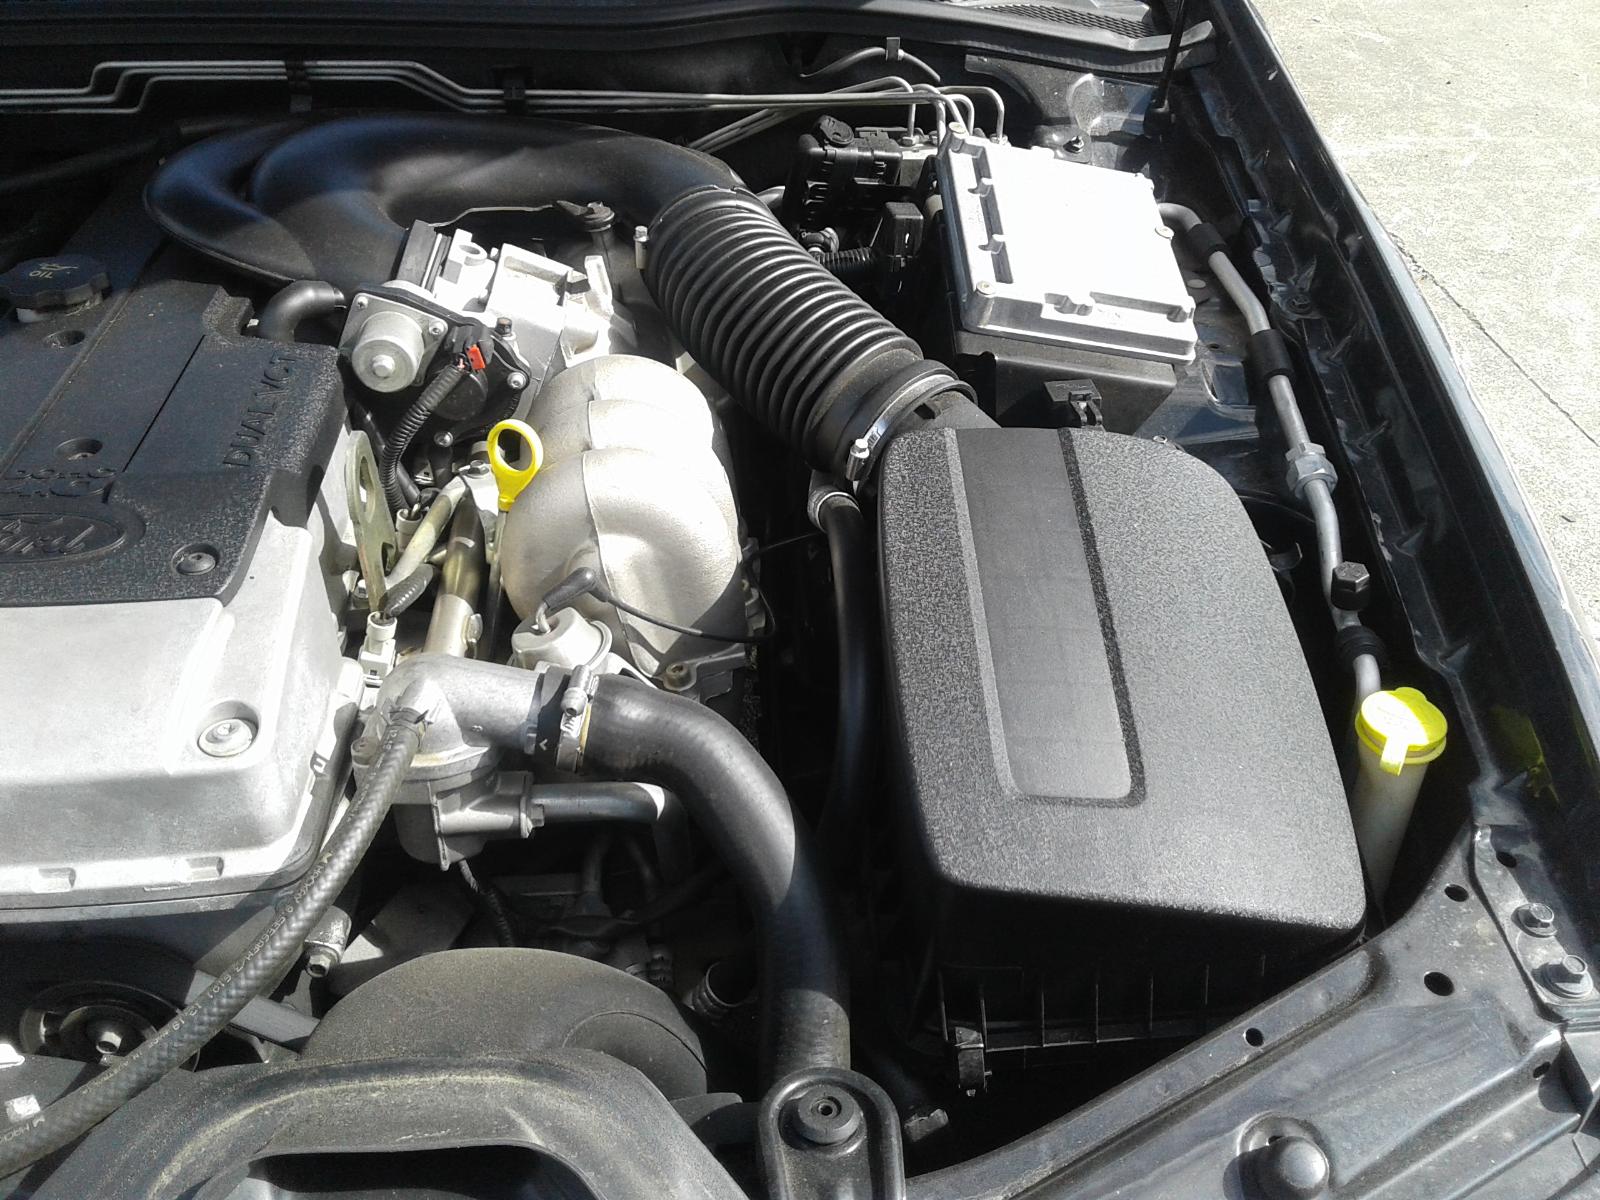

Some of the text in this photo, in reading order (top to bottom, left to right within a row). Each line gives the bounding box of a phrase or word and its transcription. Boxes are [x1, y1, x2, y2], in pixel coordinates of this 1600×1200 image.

[28, 270, 53, 279] OIL
[222, 348, 298, 467] DUAL VCT
